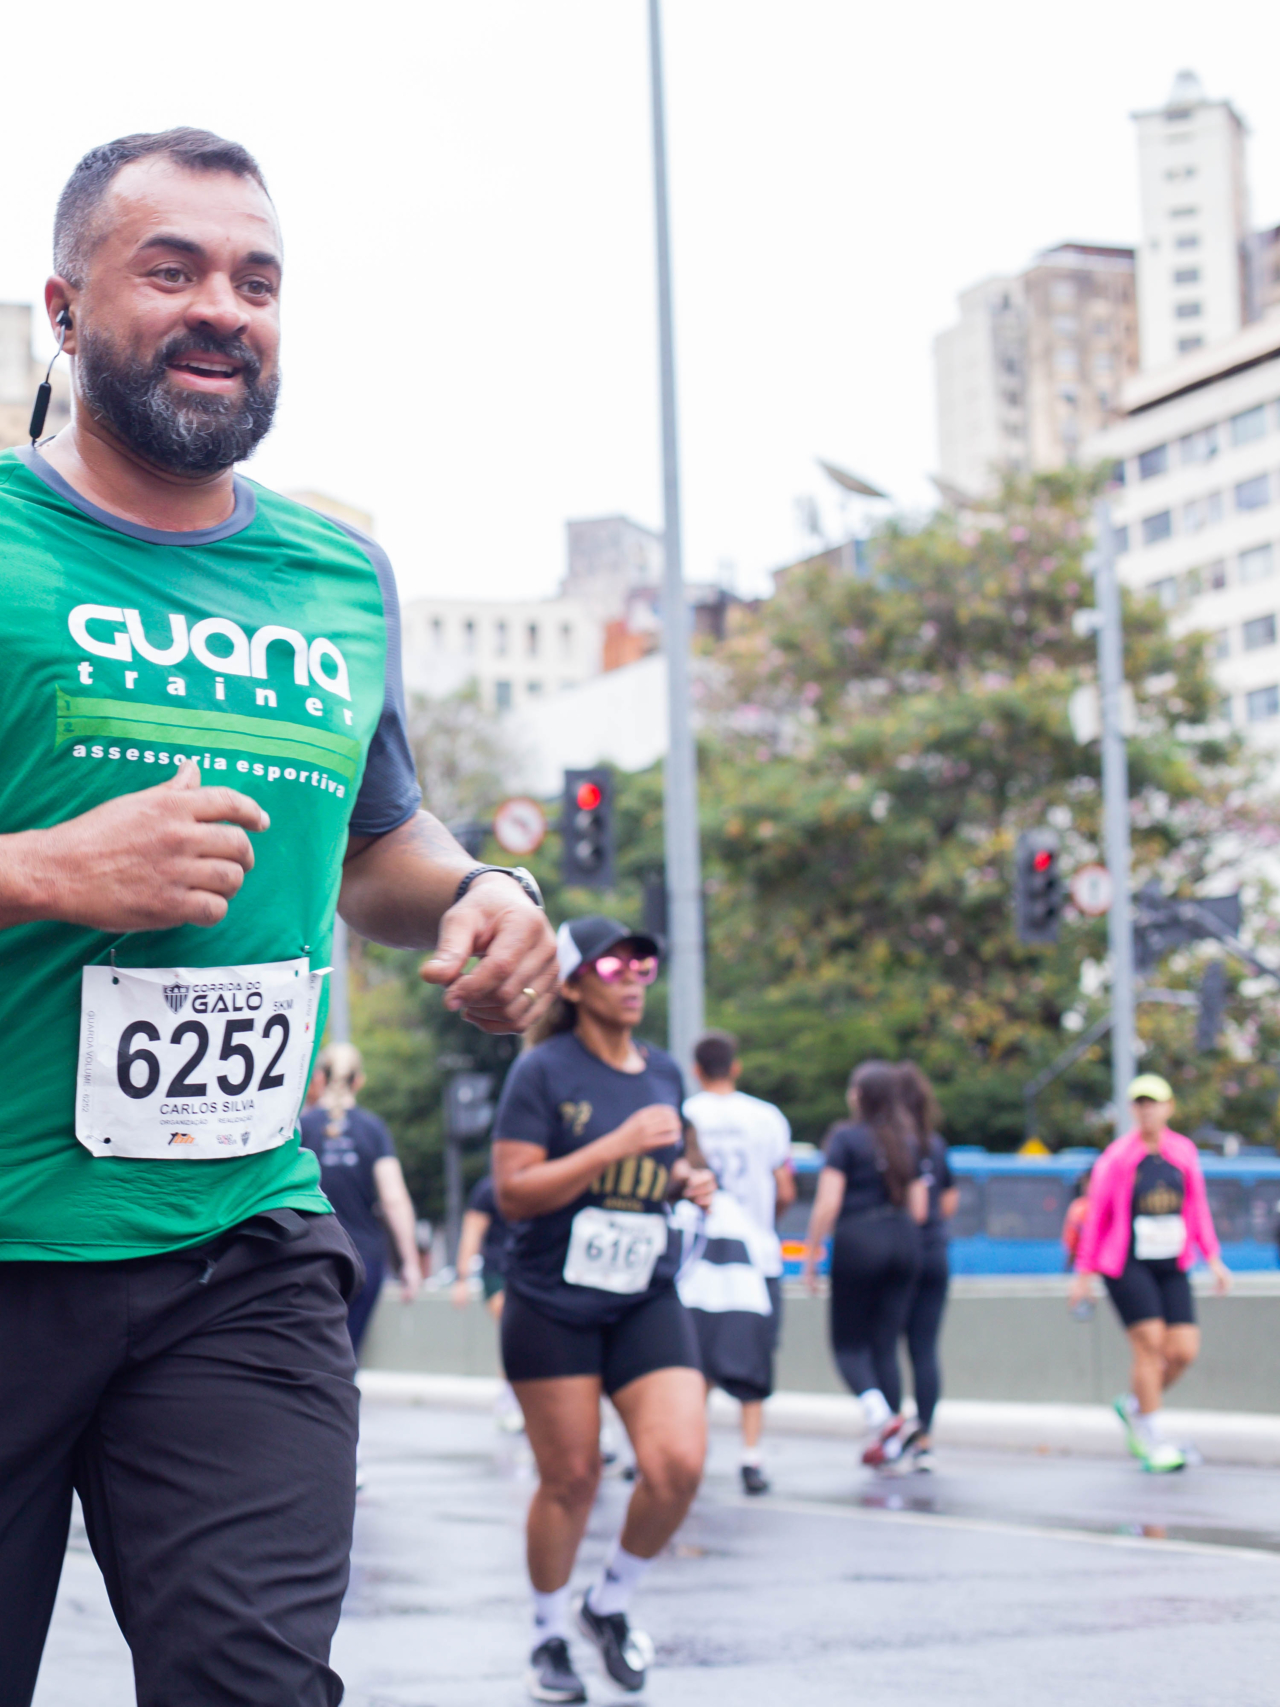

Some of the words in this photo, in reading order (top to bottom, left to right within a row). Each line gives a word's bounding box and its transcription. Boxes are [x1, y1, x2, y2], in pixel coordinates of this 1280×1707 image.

[78, 661, 353, 726] trainer
[72, 744, 227, 770] assessoria
[236, 760, 345, 798] esportiva
[192, 983, 242, 993] CORRIDA
[246, 981, 261, 990] DO
[192, 991, 263, 1014] GALO
[117, 1013, 290, 1099] 6252
[160, 1102, 217, 1115] CARLOS
[222, 1099, 255, 1113] SILVA
